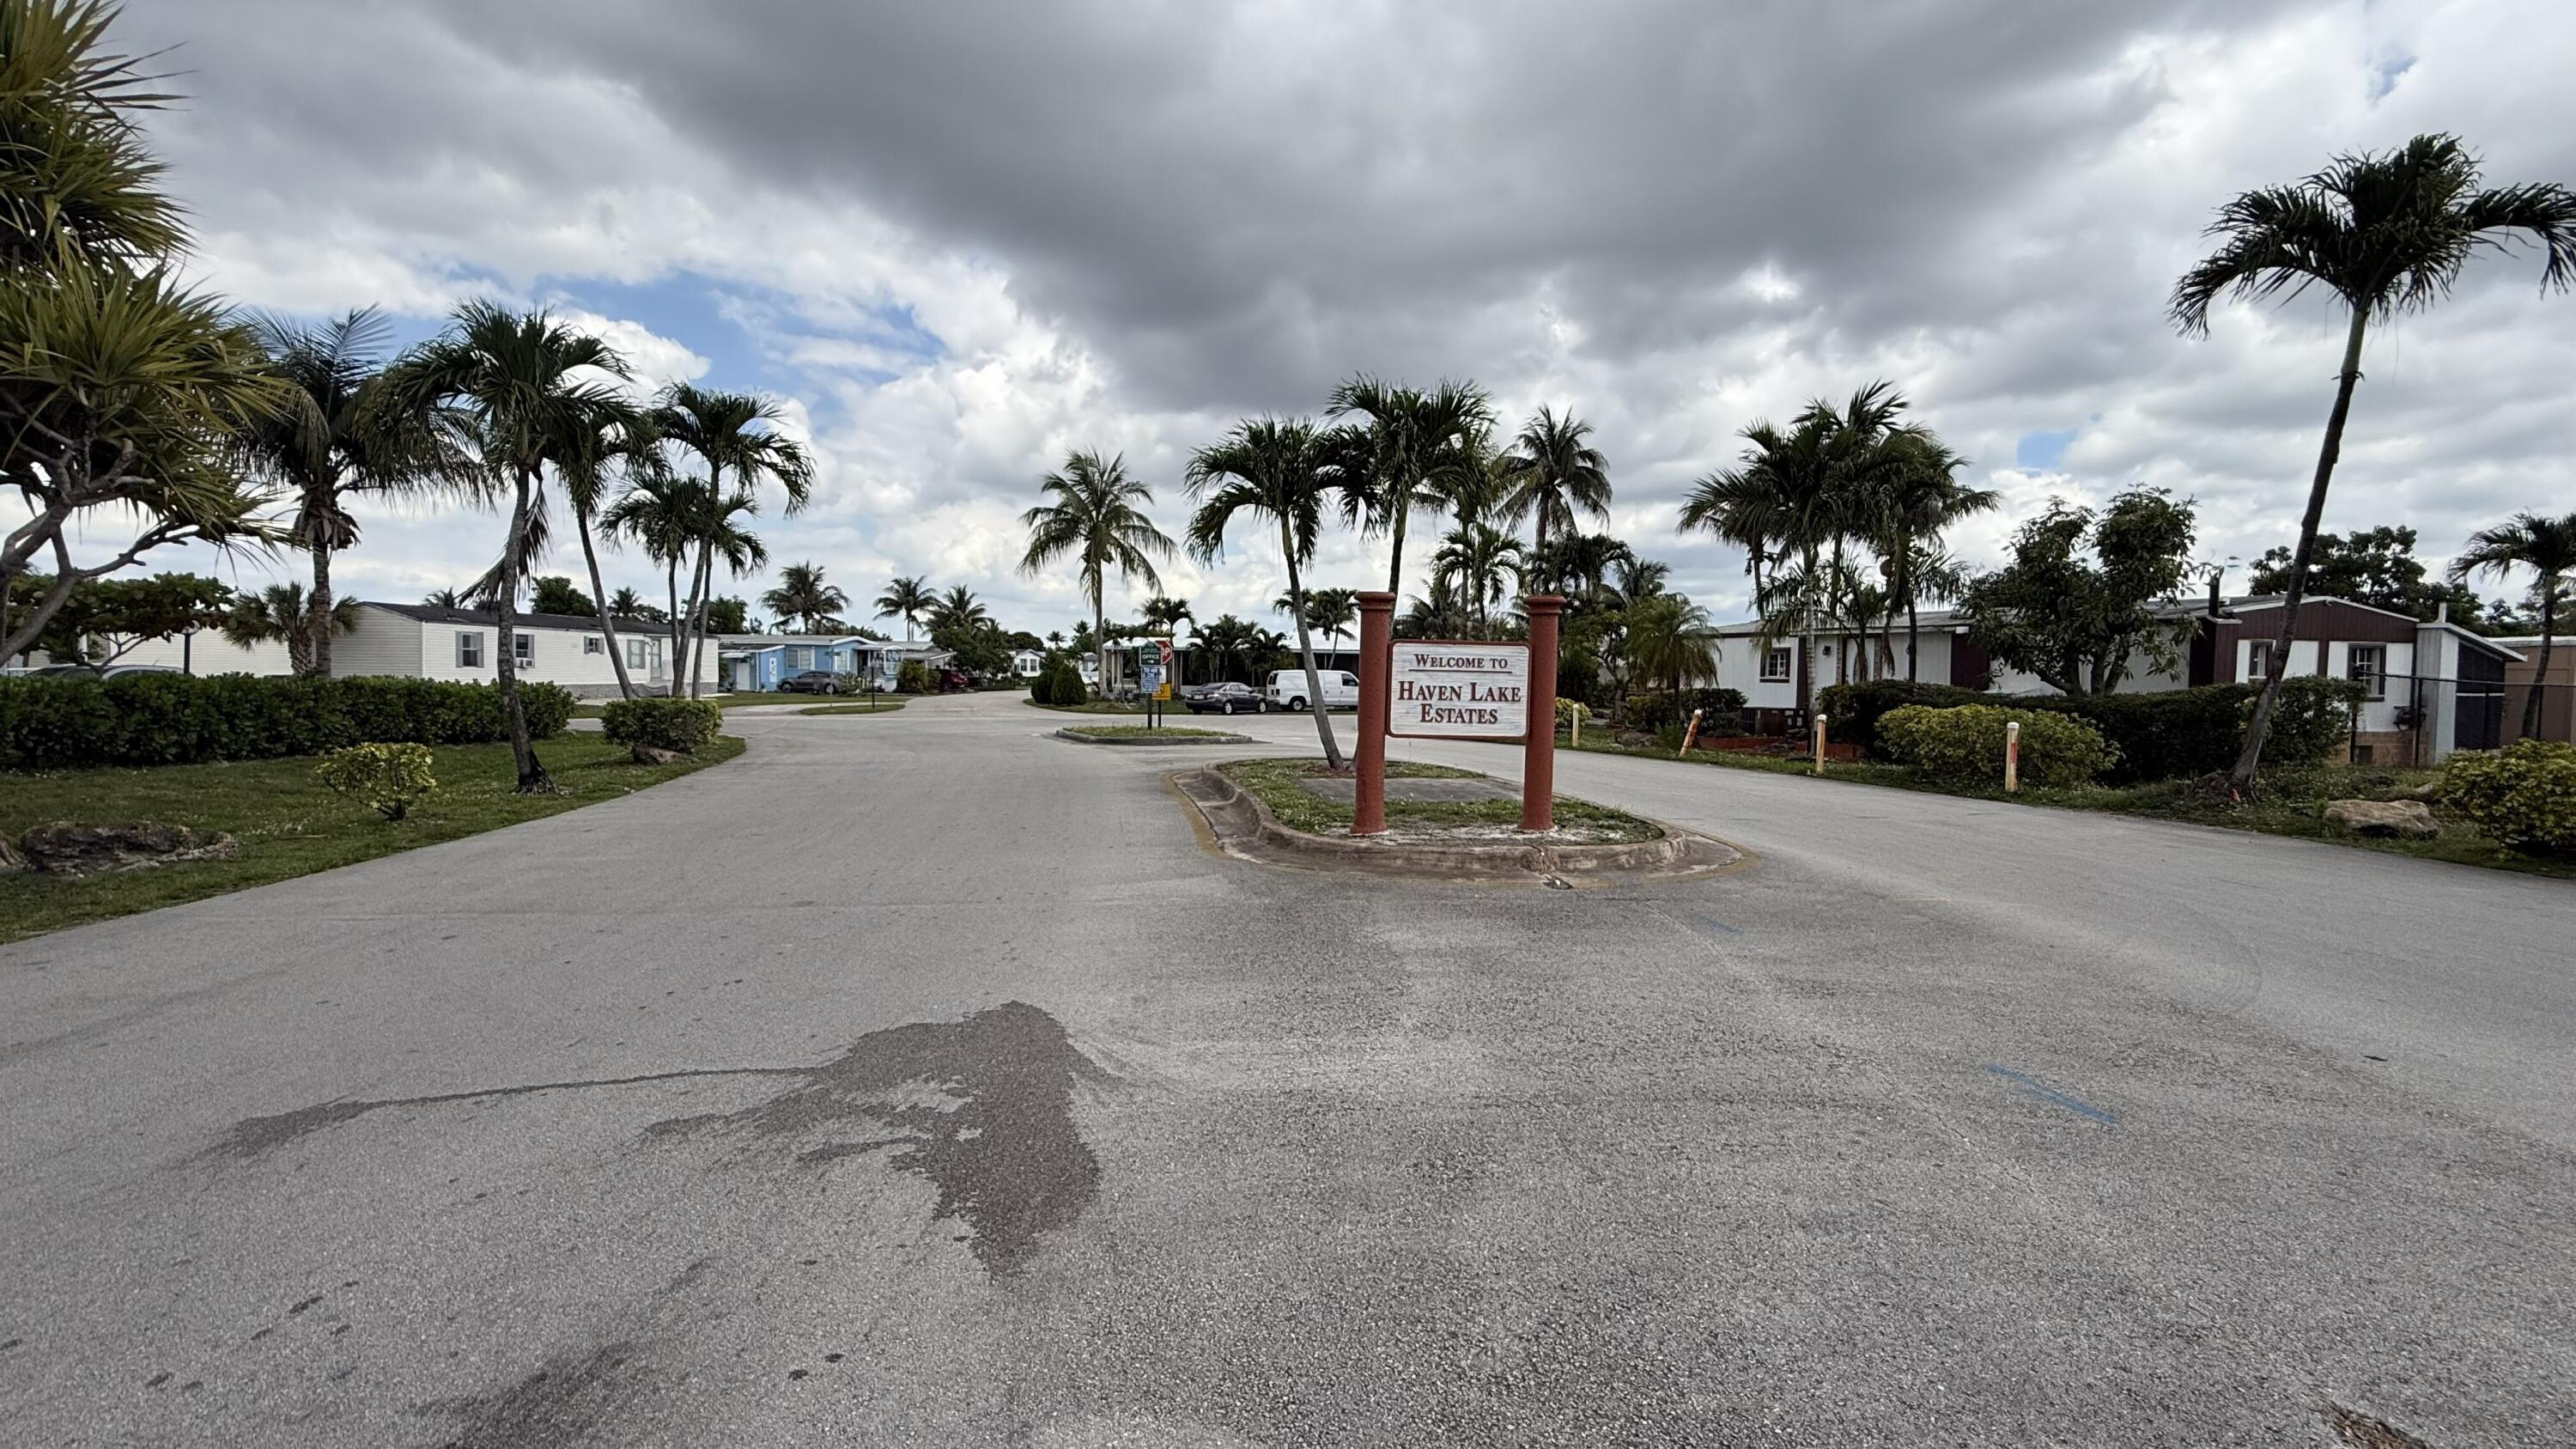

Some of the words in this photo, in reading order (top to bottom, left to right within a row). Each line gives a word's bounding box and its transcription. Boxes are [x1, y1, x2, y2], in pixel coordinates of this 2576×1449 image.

[1413, 654, 1485, 668] WELCOME
[1490, 658, 1508, 668] TO
[1398, 681, 1462, 701] HAVEN
[1469, 682, 1521, 702] LAKE
[1419, 703, 1498, 723] ESTATES
